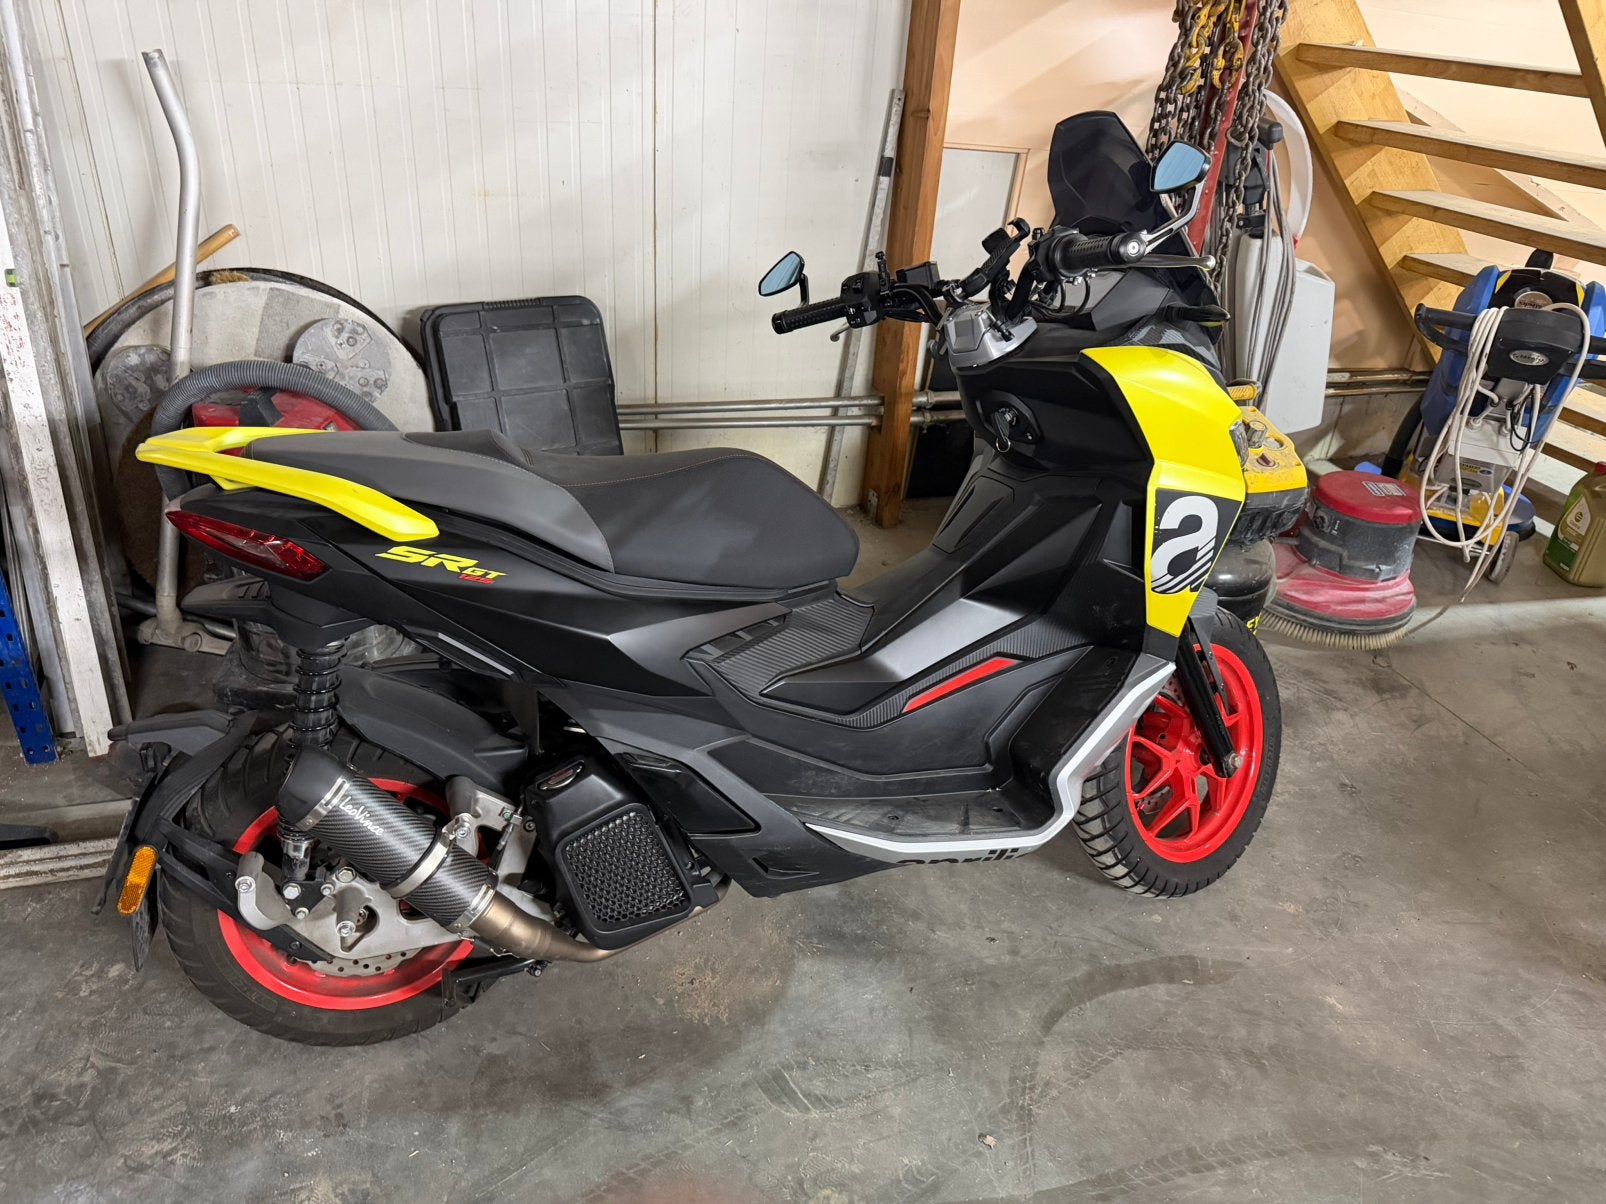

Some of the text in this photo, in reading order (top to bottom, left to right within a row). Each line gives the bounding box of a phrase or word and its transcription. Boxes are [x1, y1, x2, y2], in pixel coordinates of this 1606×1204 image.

[375, 545, 509, 579] SR GT
[338, 796, 385, 836] LeoVince
